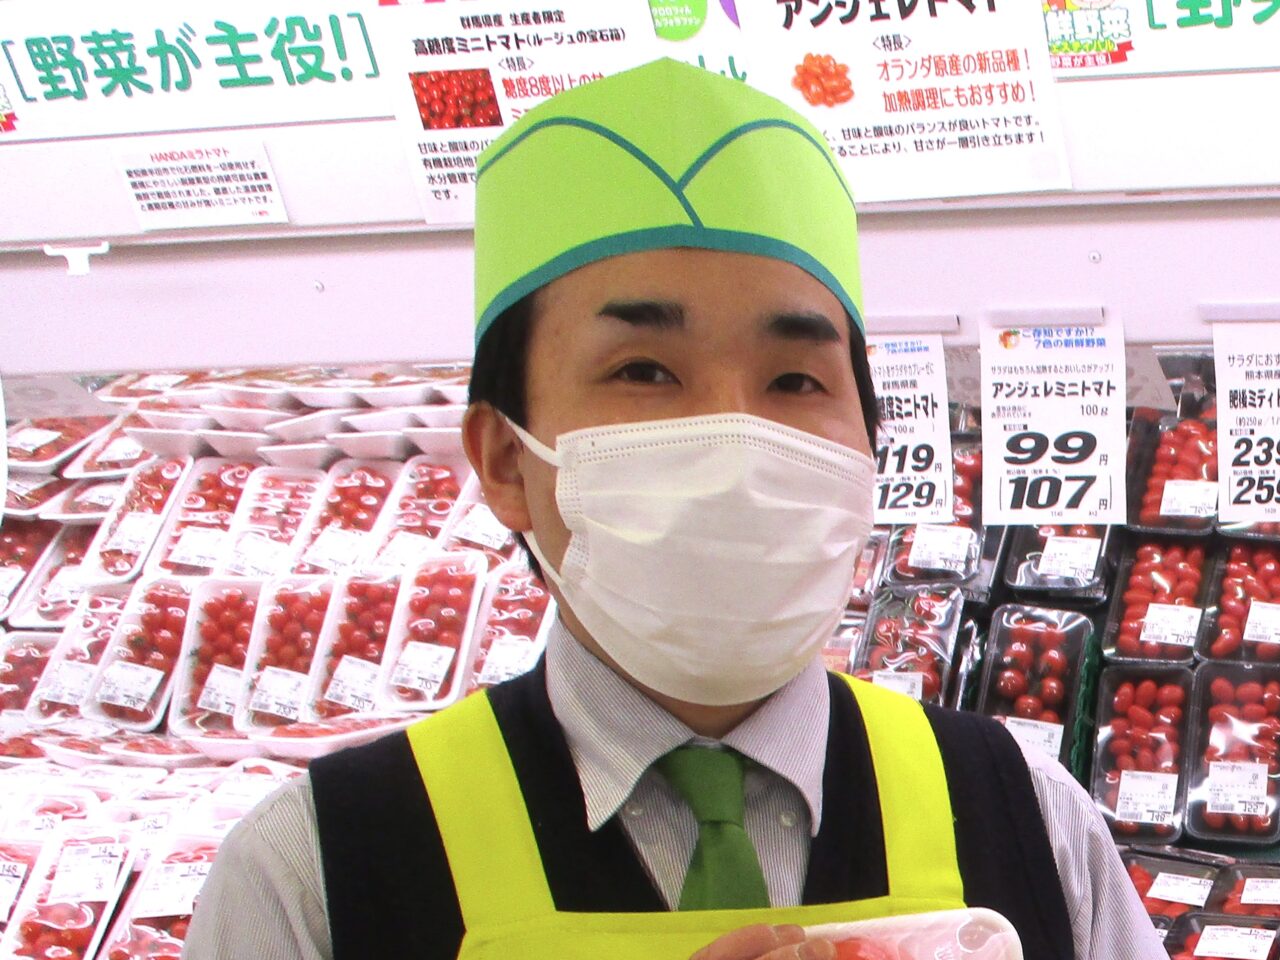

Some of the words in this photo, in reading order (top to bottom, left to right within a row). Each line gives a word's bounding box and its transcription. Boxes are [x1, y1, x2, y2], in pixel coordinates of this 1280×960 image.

[991, 379, 1117, 399] アンジェレミニトマト
[876, 443, 935, 474] 119
[1003, 431, 1098, 465] 99
[877, 481, 937, 510] 129
[1008, 475, 1097, 510] 107
